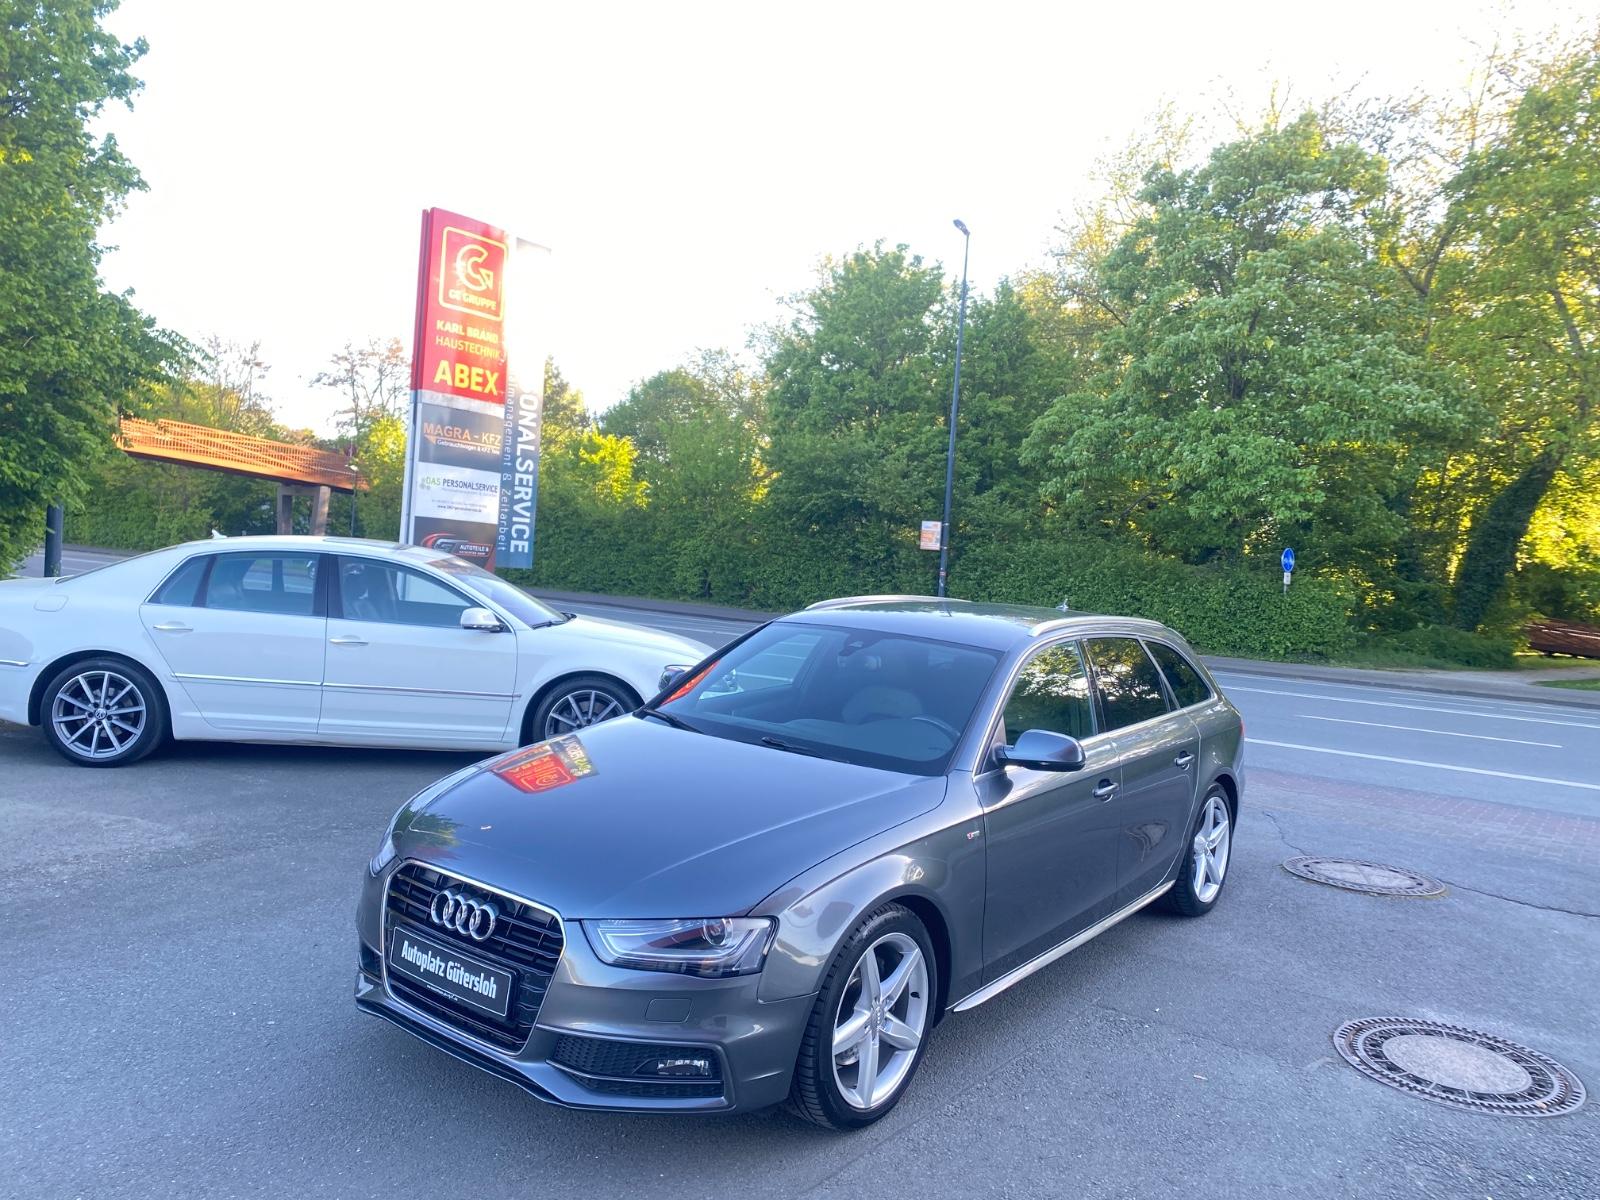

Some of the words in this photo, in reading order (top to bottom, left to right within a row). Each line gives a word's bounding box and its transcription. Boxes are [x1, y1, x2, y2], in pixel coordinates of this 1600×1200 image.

[436, 320, 465, 336] KARL
[433, 359, 500, 397] ABEX
[423, 422, 471, 441] MAGRA
[481, 432, 502, 447] KFZ
[442, 478, 498, 494] PERSONALSERVICE
[498, 488, 511, 551] Zeitarbeit
[401, 940, 446, 977] Autoplatz
[446, 960, 498, 999] Gütersloh
